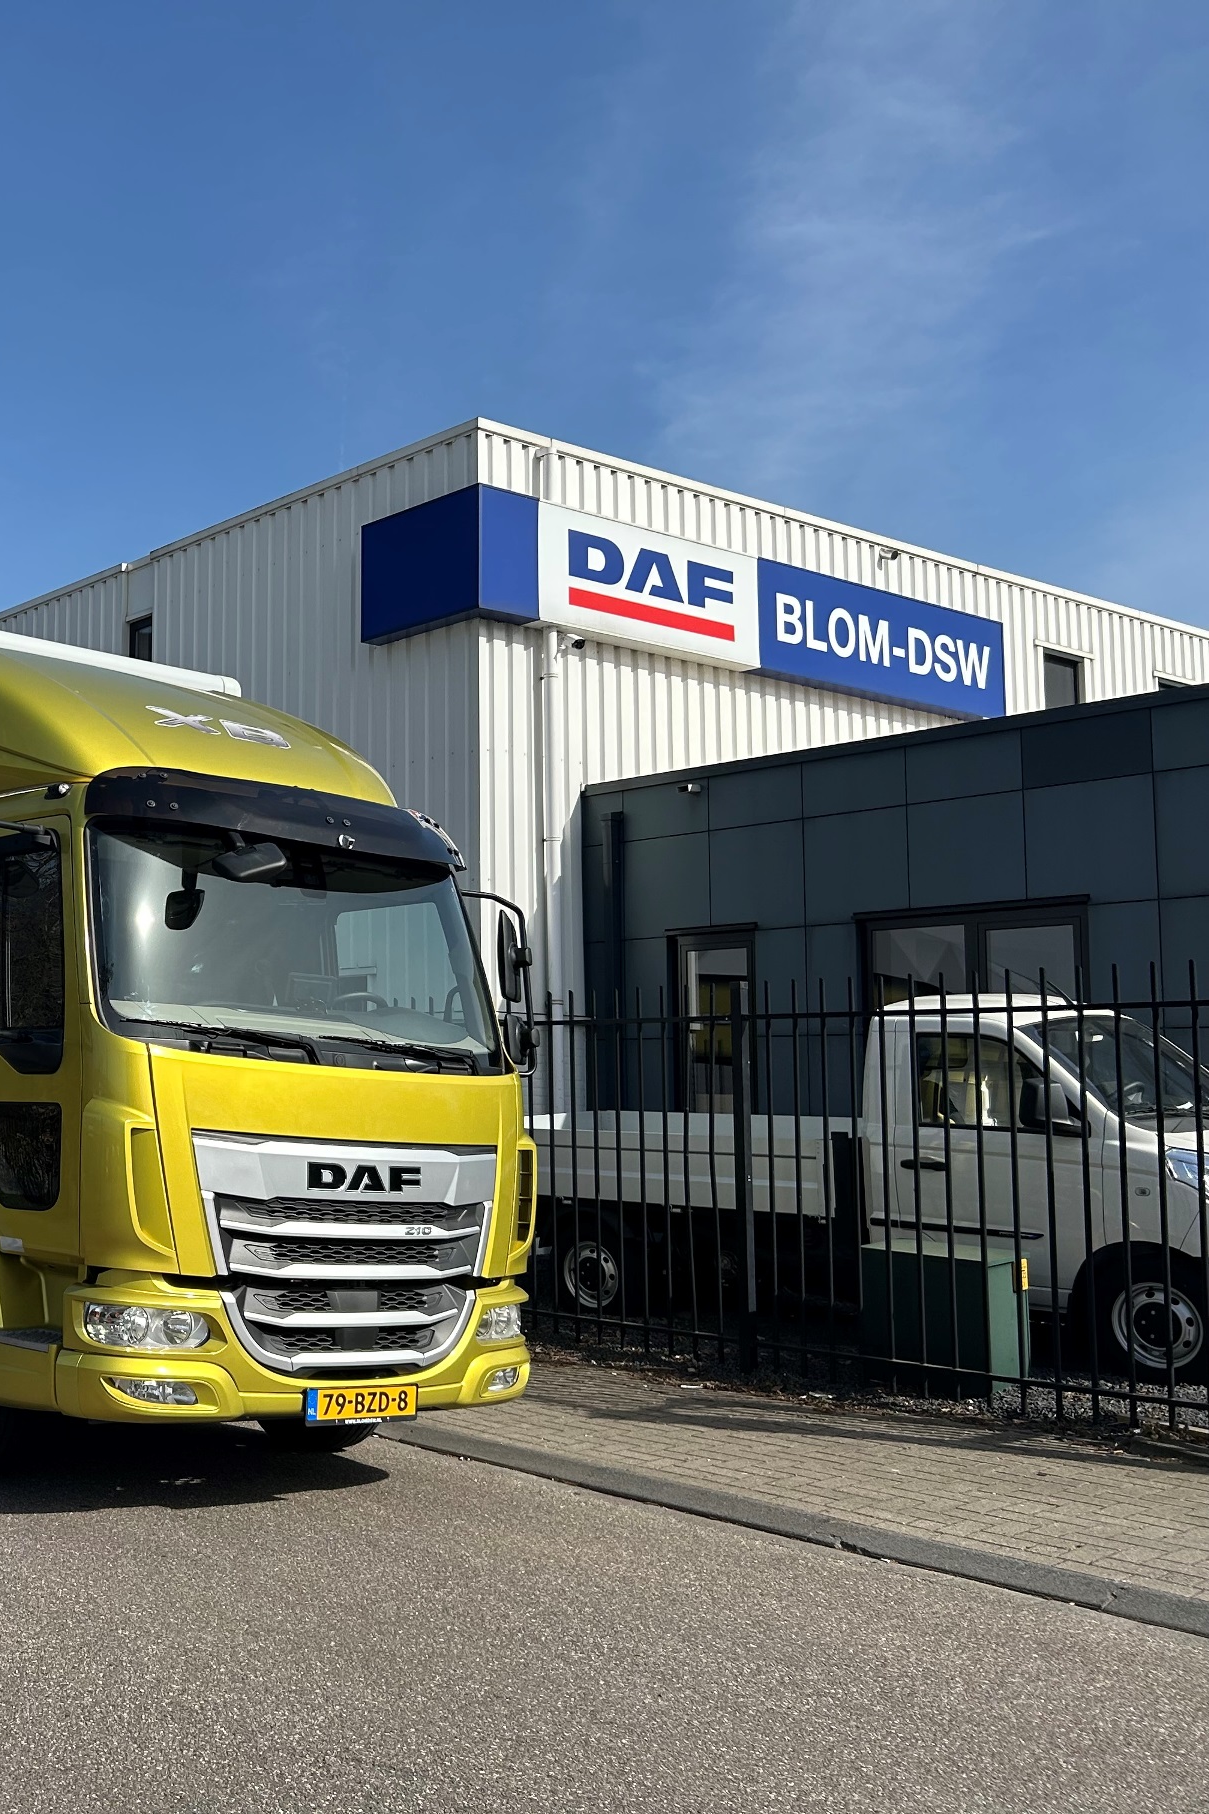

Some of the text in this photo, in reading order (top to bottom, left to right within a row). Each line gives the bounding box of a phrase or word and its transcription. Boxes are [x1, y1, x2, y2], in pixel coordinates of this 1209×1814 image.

[568, 529, 734, 608] DAF
[775, 592, 990, 690] BLOM-DSW
[145, 705, 291, 749] XB
[307, 1161, 422, 1194] DAF
[405, 1226, 432, 1236] 210
[307, 1389, 408, 1416] NL 79-BZD-8
